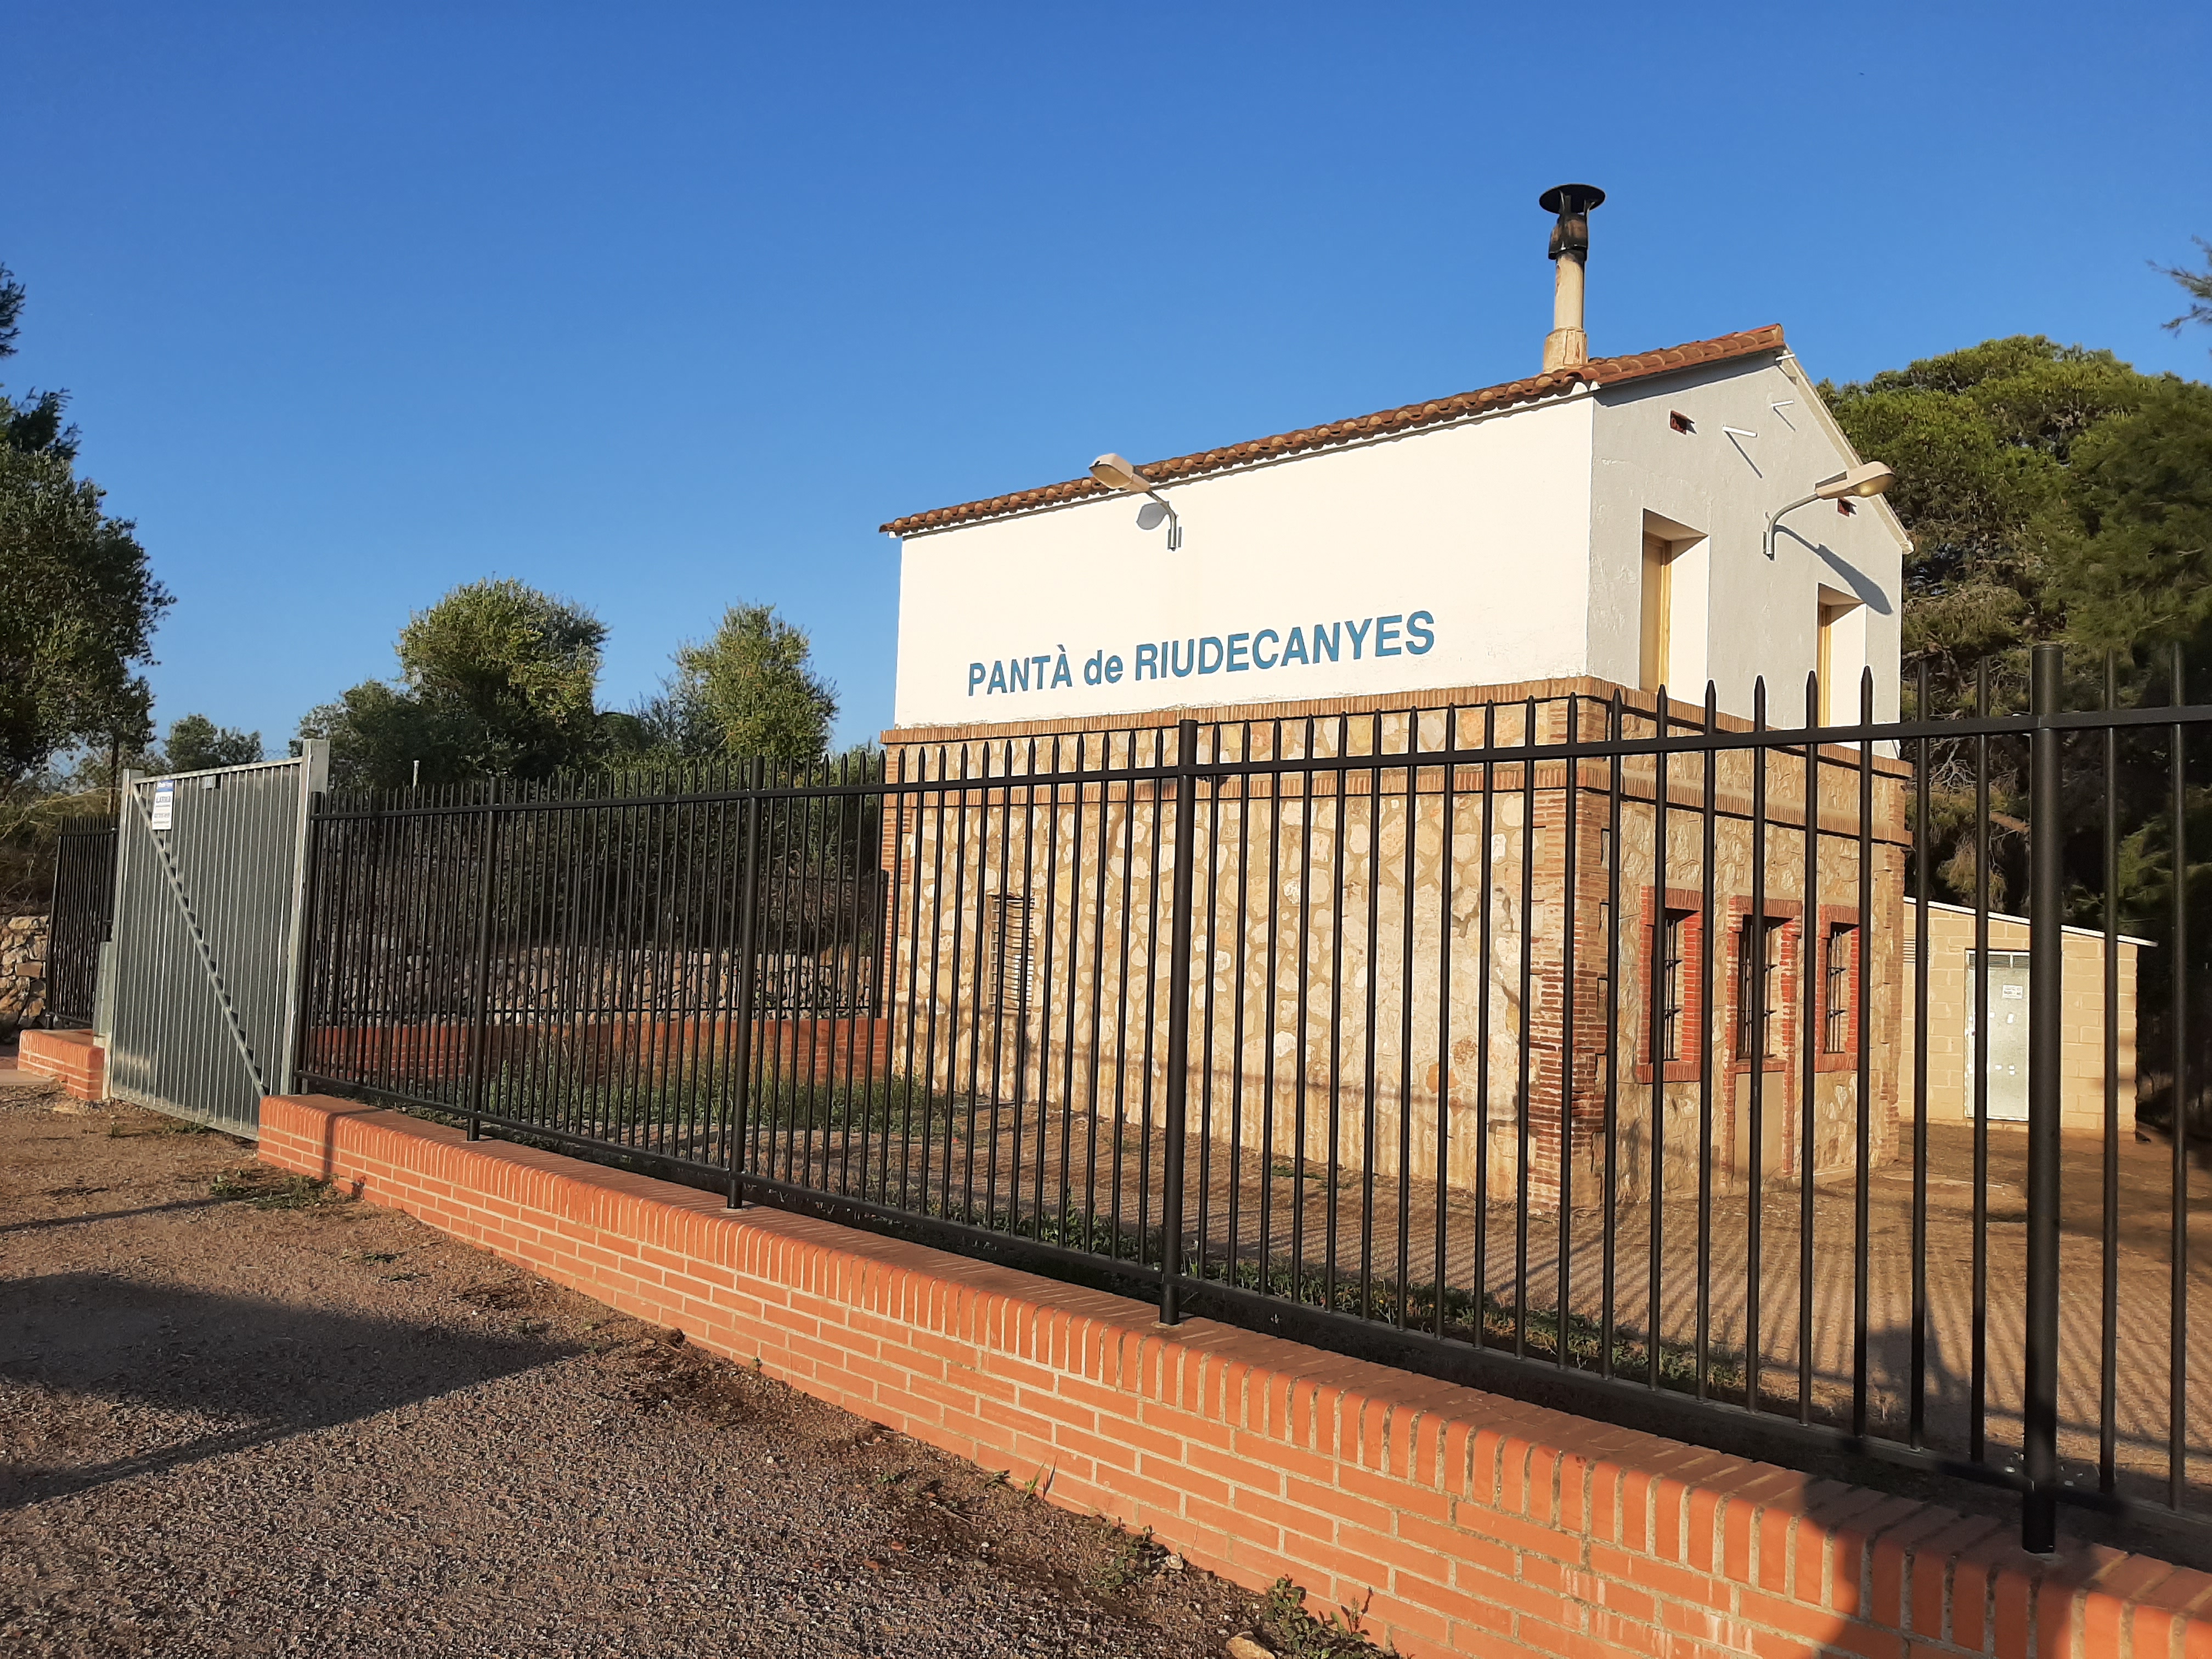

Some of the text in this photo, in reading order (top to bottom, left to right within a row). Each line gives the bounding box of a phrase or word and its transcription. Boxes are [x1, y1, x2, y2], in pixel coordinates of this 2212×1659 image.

[968, 611, 1435, 696] PANTÀ de RIUDECANYES
